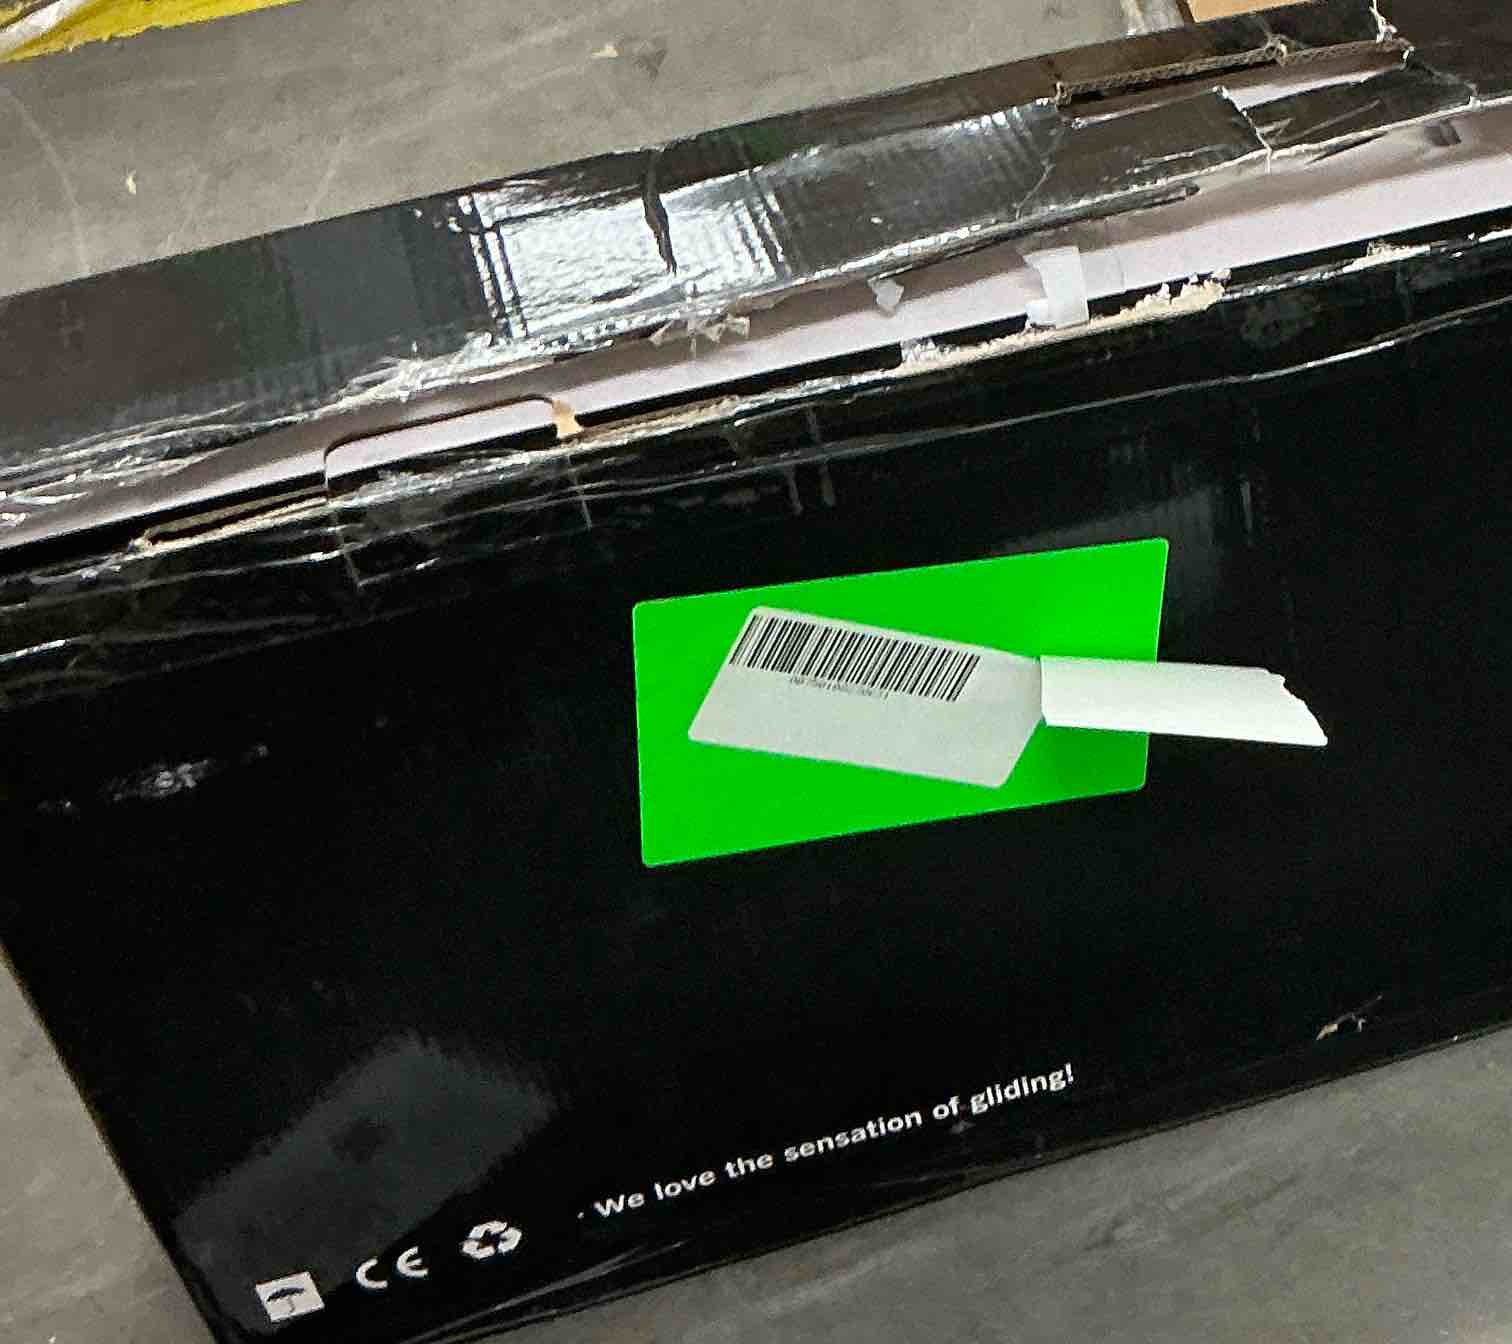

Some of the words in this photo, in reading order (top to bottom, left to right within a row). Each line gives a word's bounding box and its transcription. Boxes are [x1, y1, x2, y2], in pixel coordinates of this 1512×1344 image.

[593, 1191, 645, 1218] We
[654, 1170, 717, 1202] love
[725, 1152, 774, 1179] the
[784, 1109, 923, 1163] sensation
[933, 1095, 961, 1121] of
[970, 1062, 1075, 1115] gliding!
